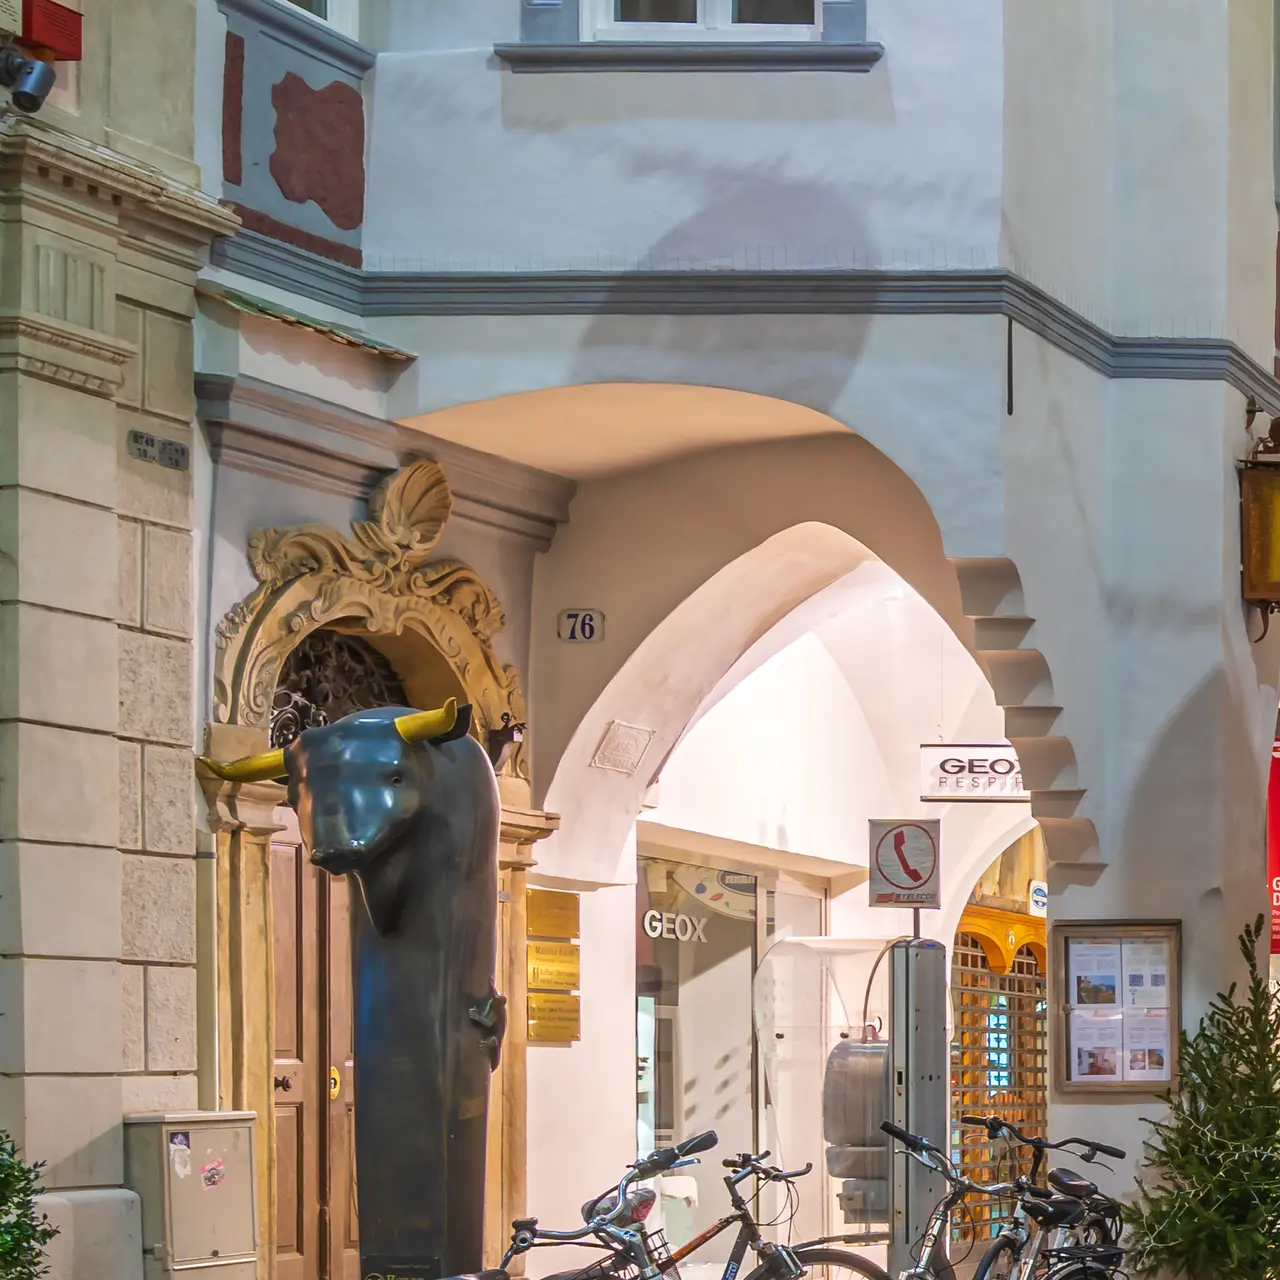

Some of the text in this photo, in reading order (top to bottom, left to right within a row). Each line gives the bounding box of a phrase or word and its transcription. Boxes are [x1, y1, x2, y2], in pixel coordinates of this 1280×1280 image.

[567, 613, 595, 640] 76
[940, 758, 1021, 775] GEO
[643, 909, 707, 943] GEOX
